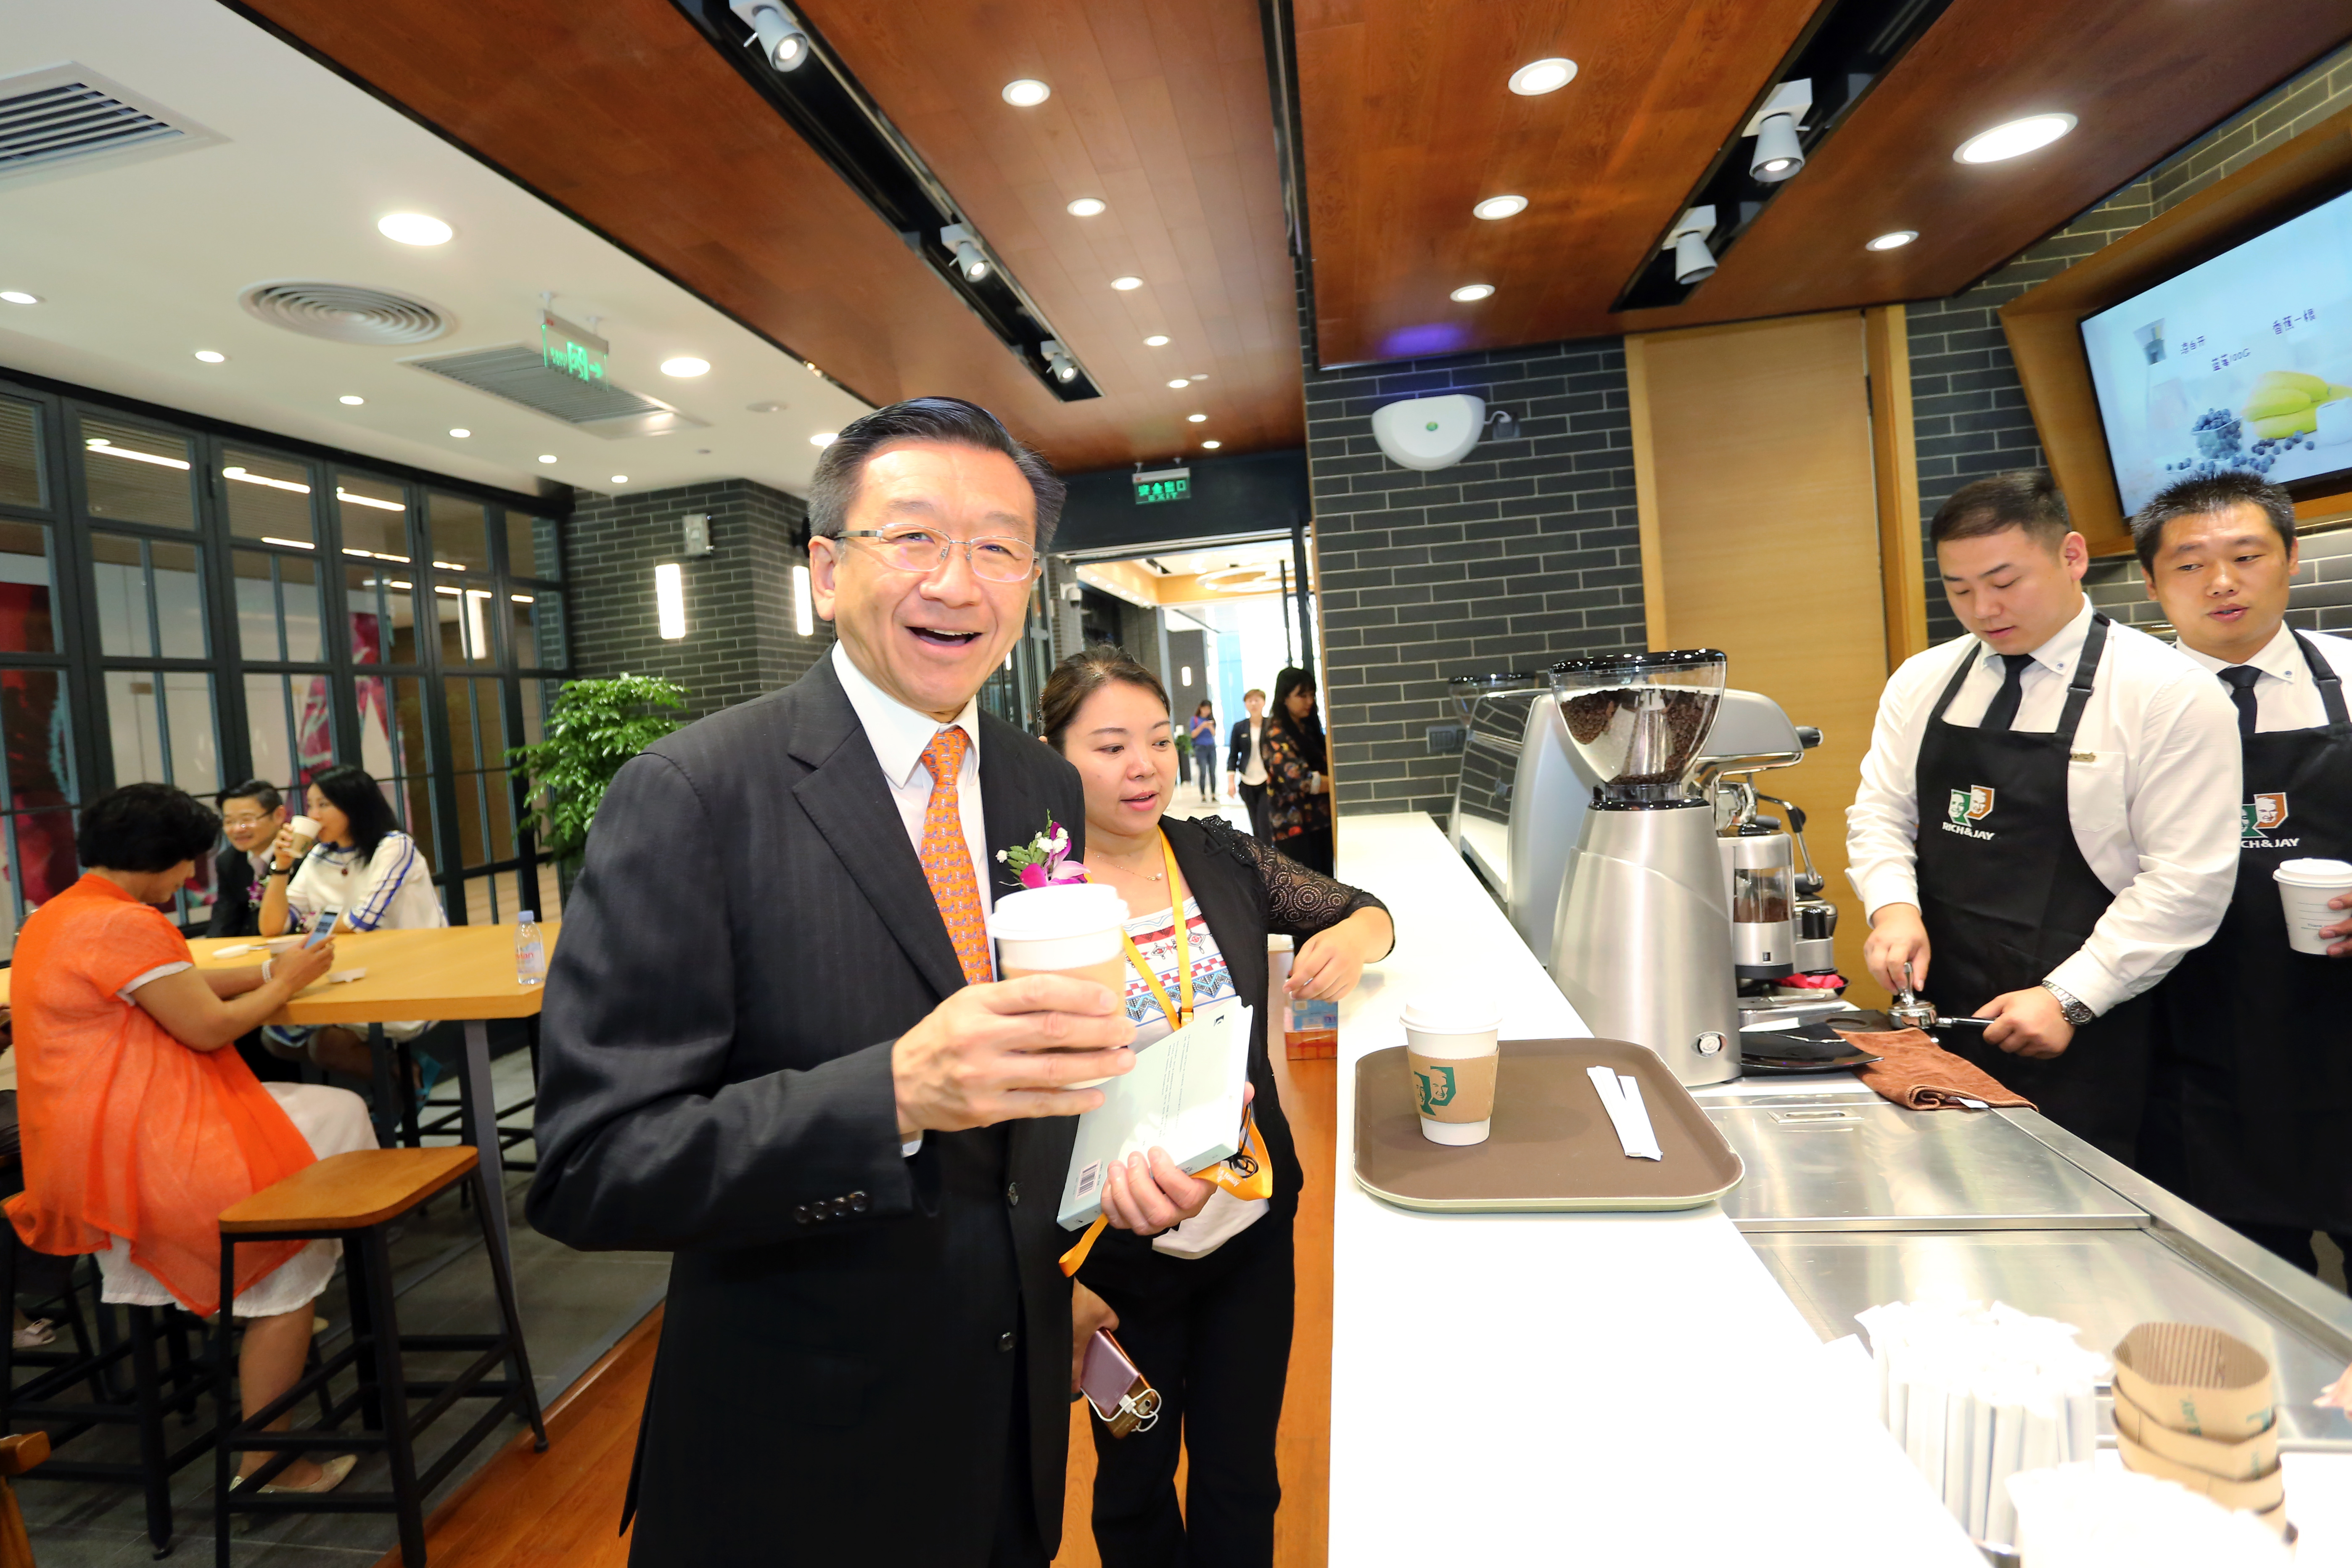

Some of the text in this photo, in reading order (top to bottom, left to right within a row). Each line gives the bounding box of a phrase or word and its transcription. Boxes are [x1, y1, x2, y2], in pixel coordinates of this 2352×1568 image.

[2273, 308, 2316, 335] 香蕉一根
[1942, 821, 1995, 841] RICH&JAY
[2240, 838, 2300, 849] CH&JAY
